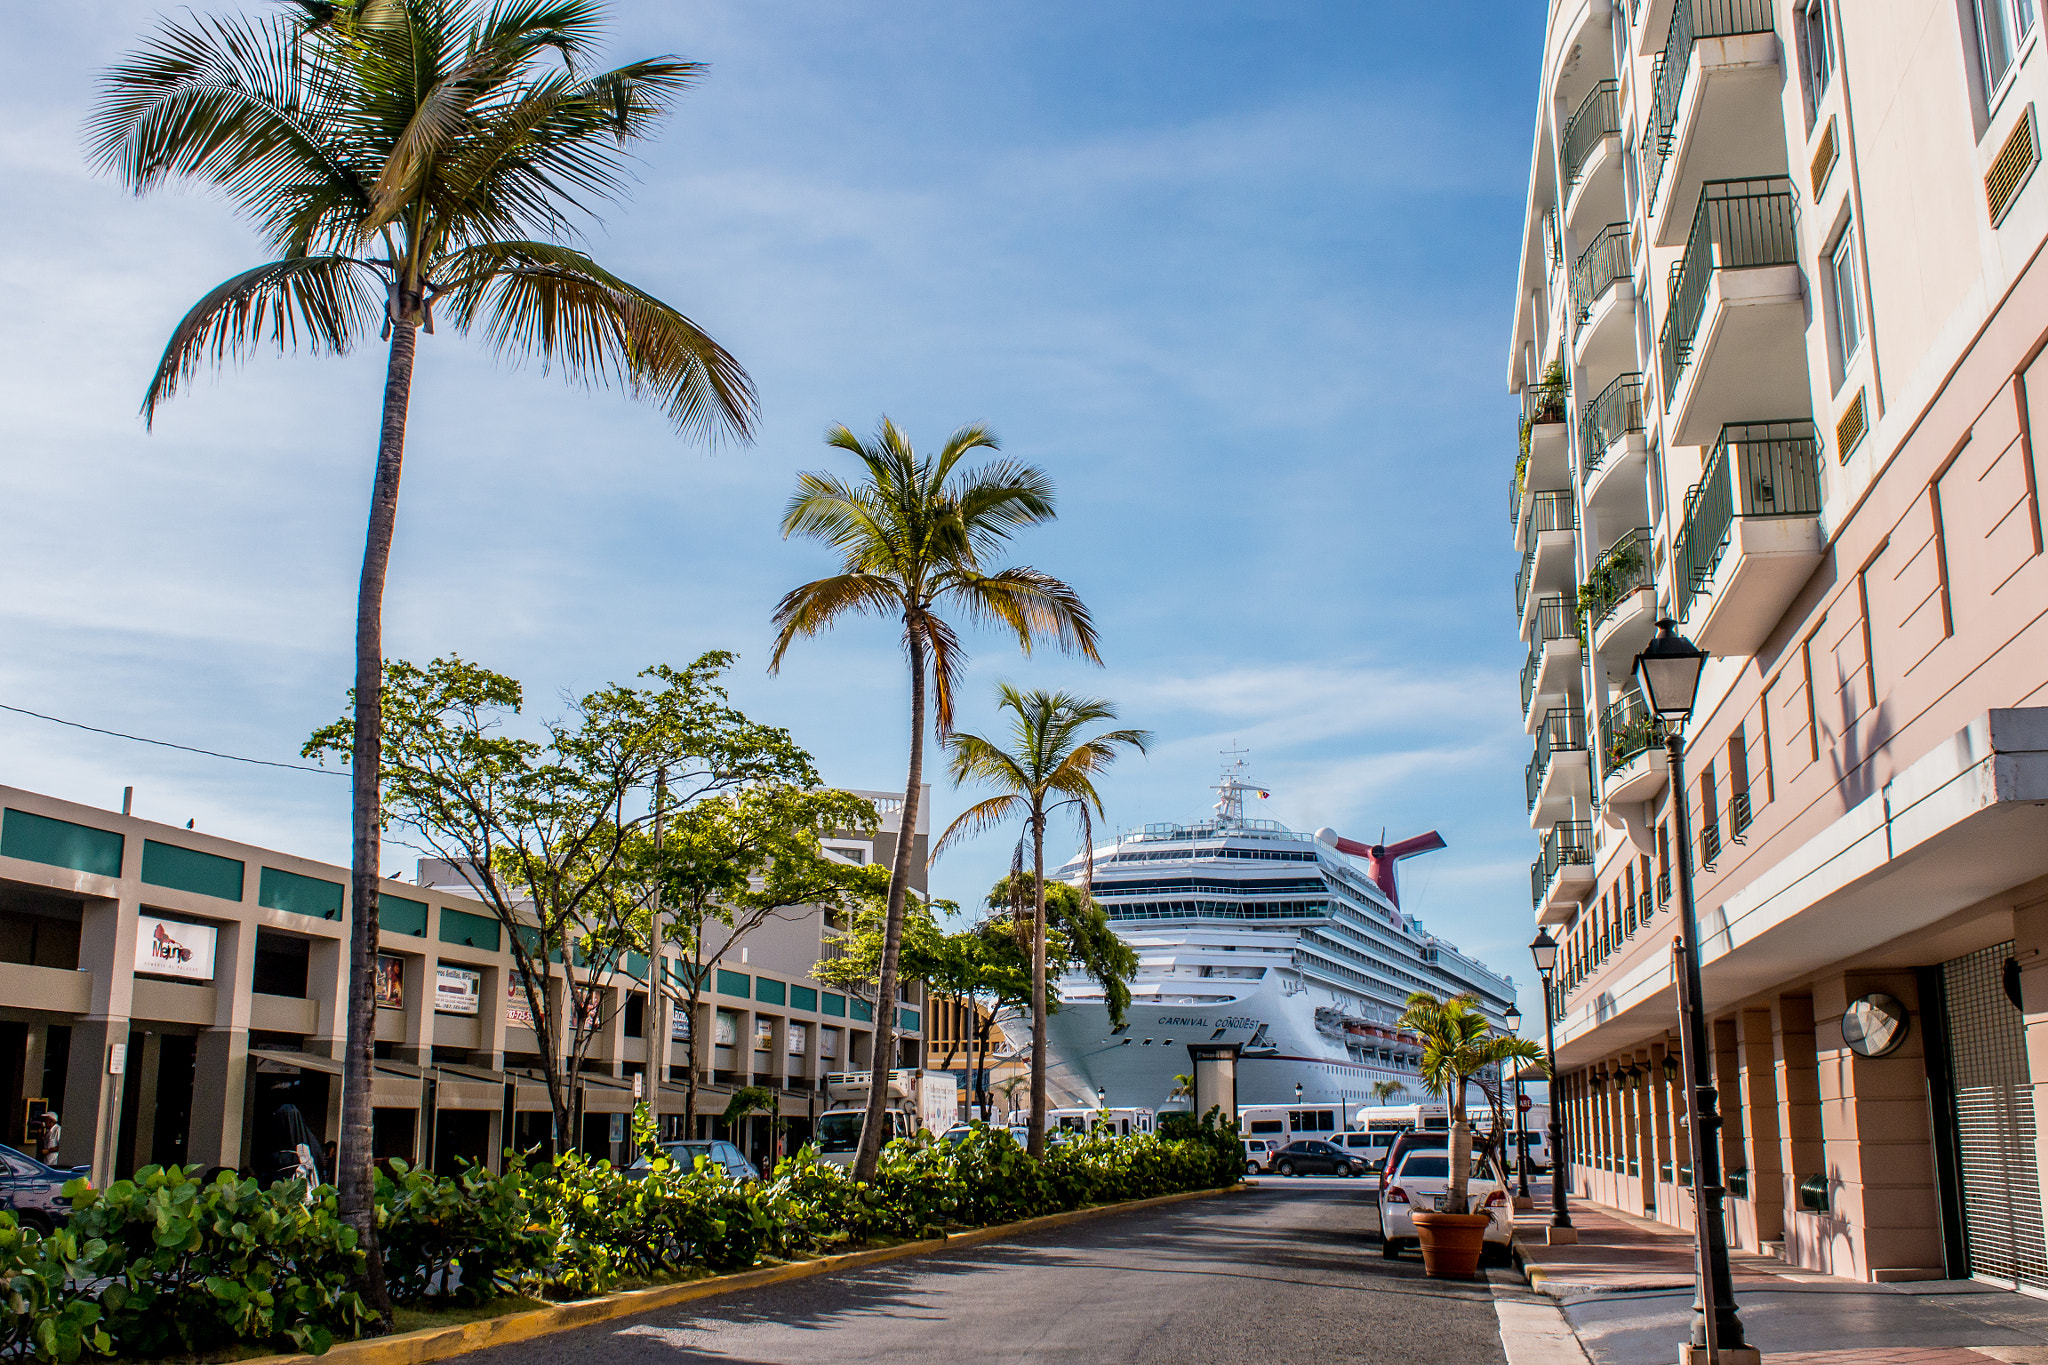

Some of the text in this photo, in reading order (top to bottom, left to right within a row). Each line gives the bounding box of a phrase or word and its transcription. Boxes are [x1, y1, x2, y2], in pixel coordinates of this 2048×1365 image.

[1158, 1017, 1260, 1030] CARNIVAL CONQUEST
[1519, 1099, 1531, 1108] ARE
